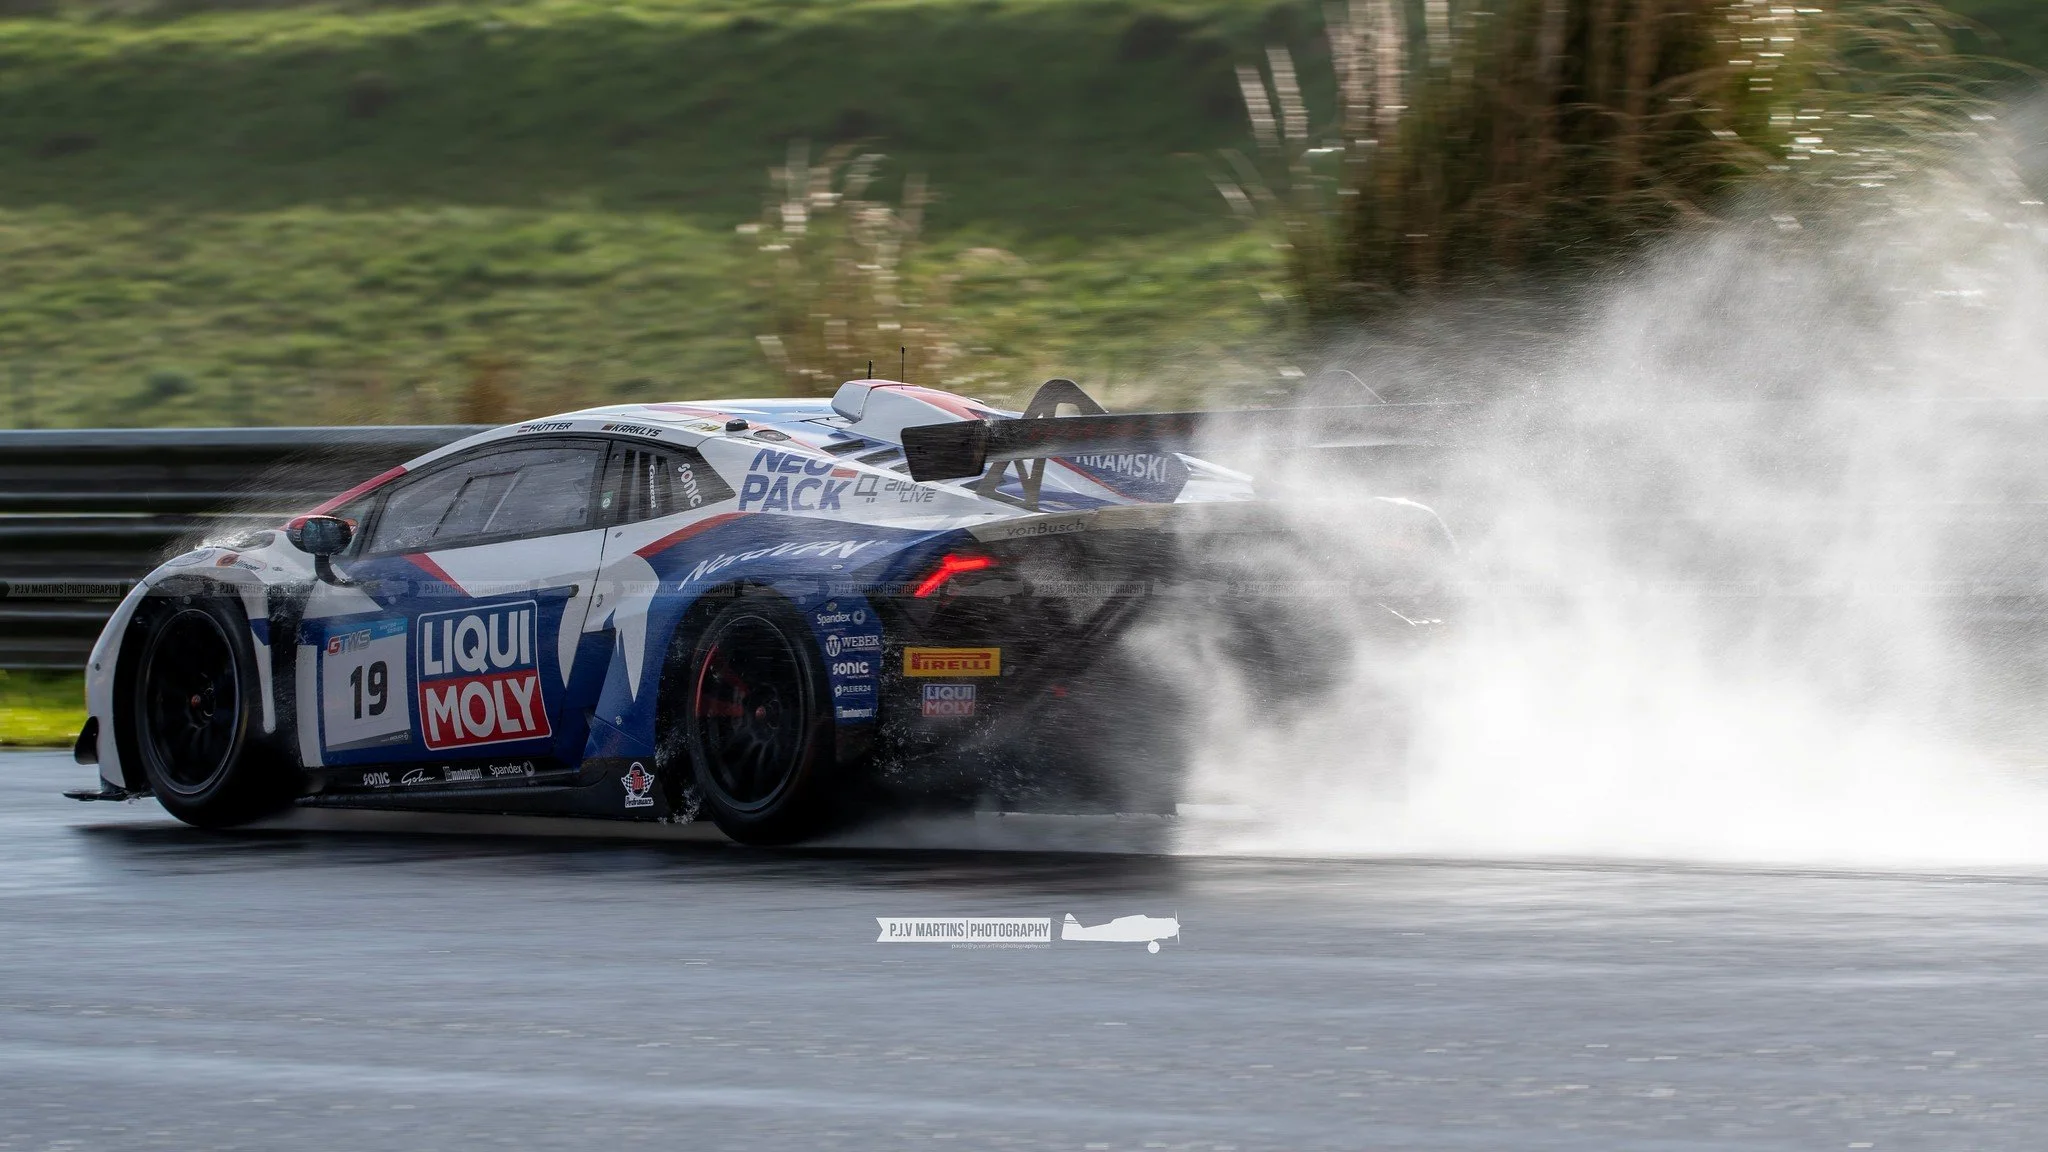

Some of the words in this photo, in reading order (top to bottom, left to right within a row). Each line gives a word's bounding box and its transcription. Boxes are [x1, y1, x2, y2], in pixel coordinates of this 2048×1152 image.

[527, 422, 573, 433] HÜTTER
[611, 424, 663, 437] KARKLYS
[738, 474, 853, 512] PACK
[900, 491, 936, 503] LIVE
[1006, 518, 1085, 536] vonBusch
[677, 540, 878, 591] NordVPN
[816, 606, 851, 626] Spandex
[328, 628, 372, 656] GTWS
[424, 609, 531, 675] LIQUI
[841, 635, 880, 648] WEBER
[911, 652, 992, 670] PIRELLI
[349, 660, 388, 720] 19
[926, 686, 972, 700] LIQUI
[425, 676, 537, 742] MOLY
[925, 701, 974, 715] MOLY
[489, 764, 523, 776] Spandex
